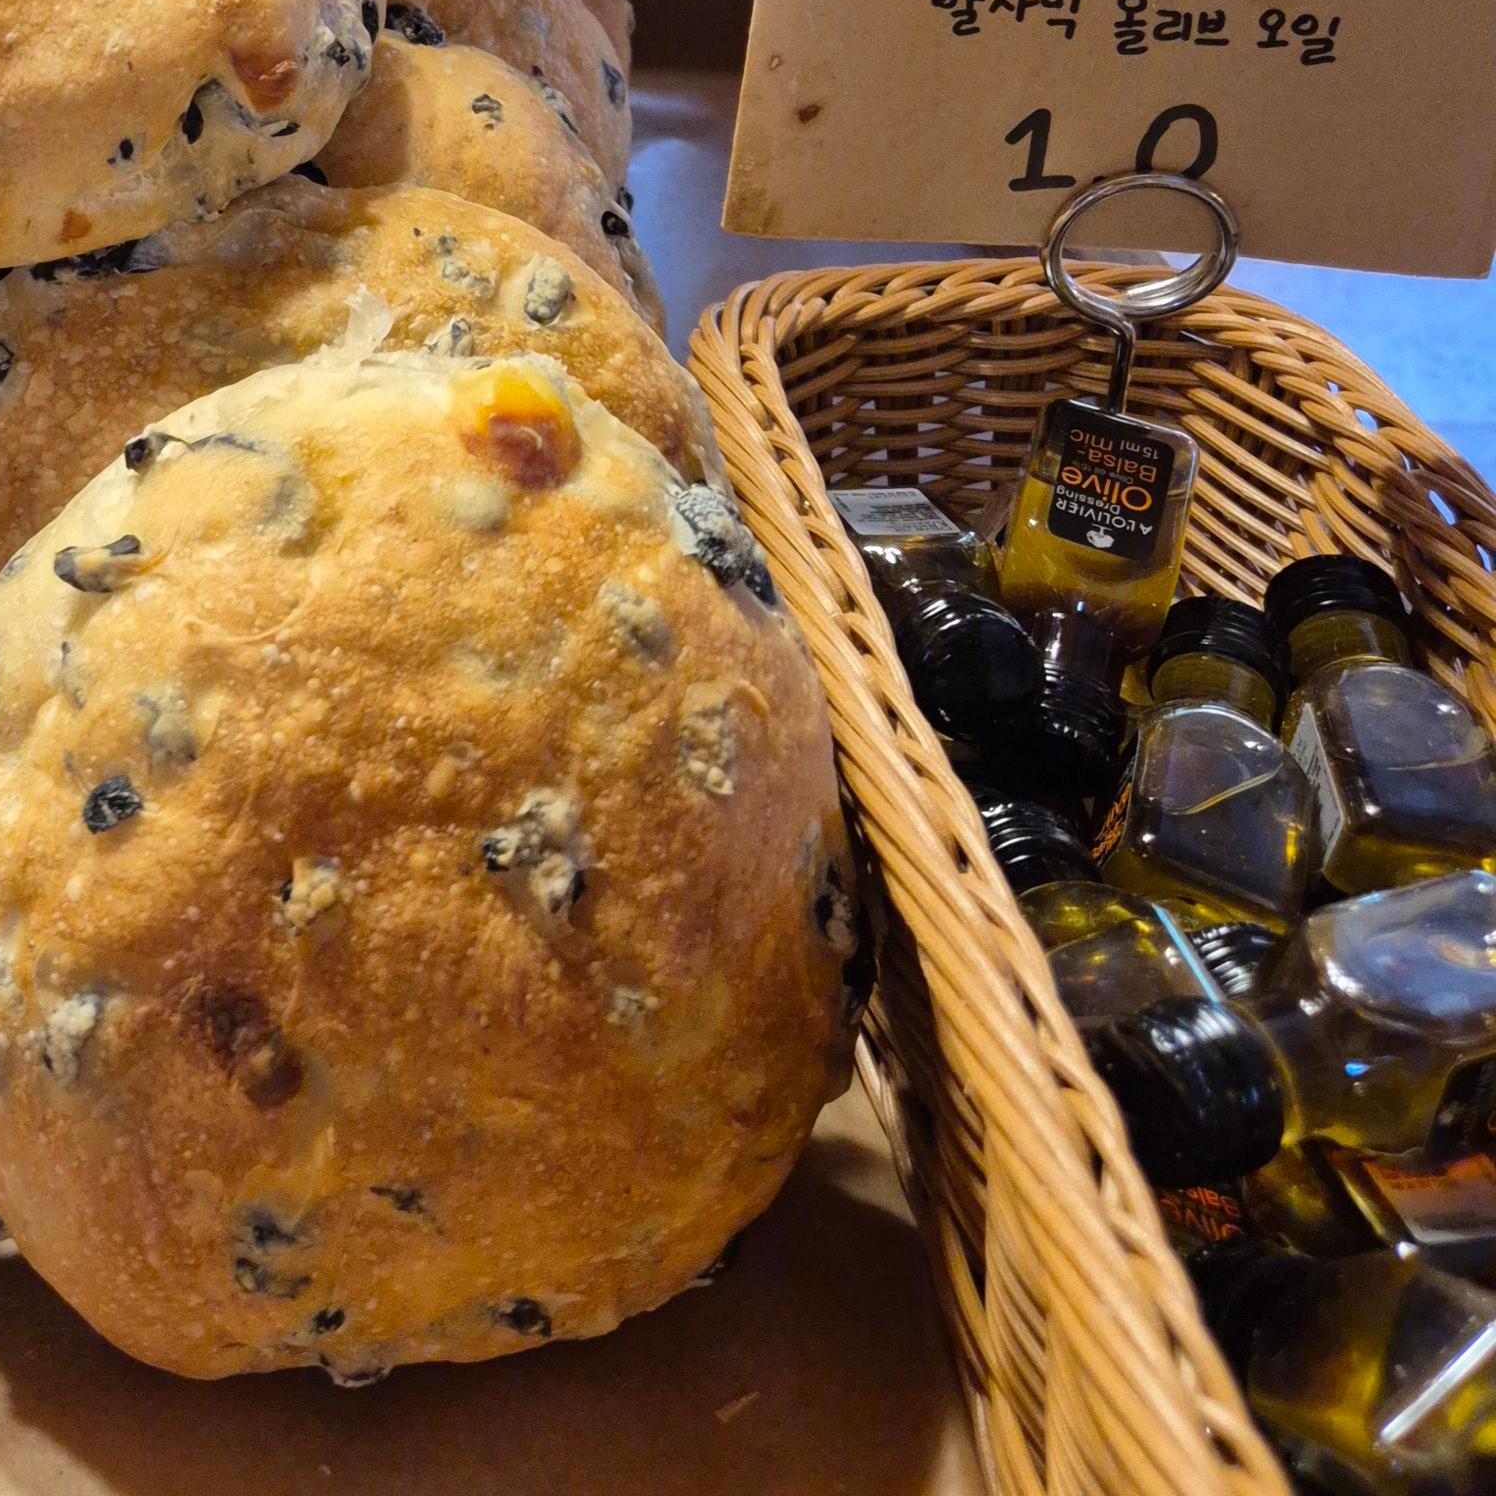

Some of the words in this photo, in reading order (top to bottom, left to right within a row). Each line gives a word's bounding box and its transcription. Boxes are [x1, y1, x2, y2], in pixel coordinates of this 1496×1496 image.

[1256, 8, 1341, 66] 오일
[1070, 429, 1113, 451] mic
[1120, 440, 1140, 453] ml
[1142, 446, 1160, 459] 15
[1077, 448, 1157, 483] Balsa-
[1056, 484, 1121, 514] Dressing
[1061, 466, 1153, 511] Olive
[1055, 497, 1135, 532] L'OLIVIER
[1139, 522, 1153, 535] A
